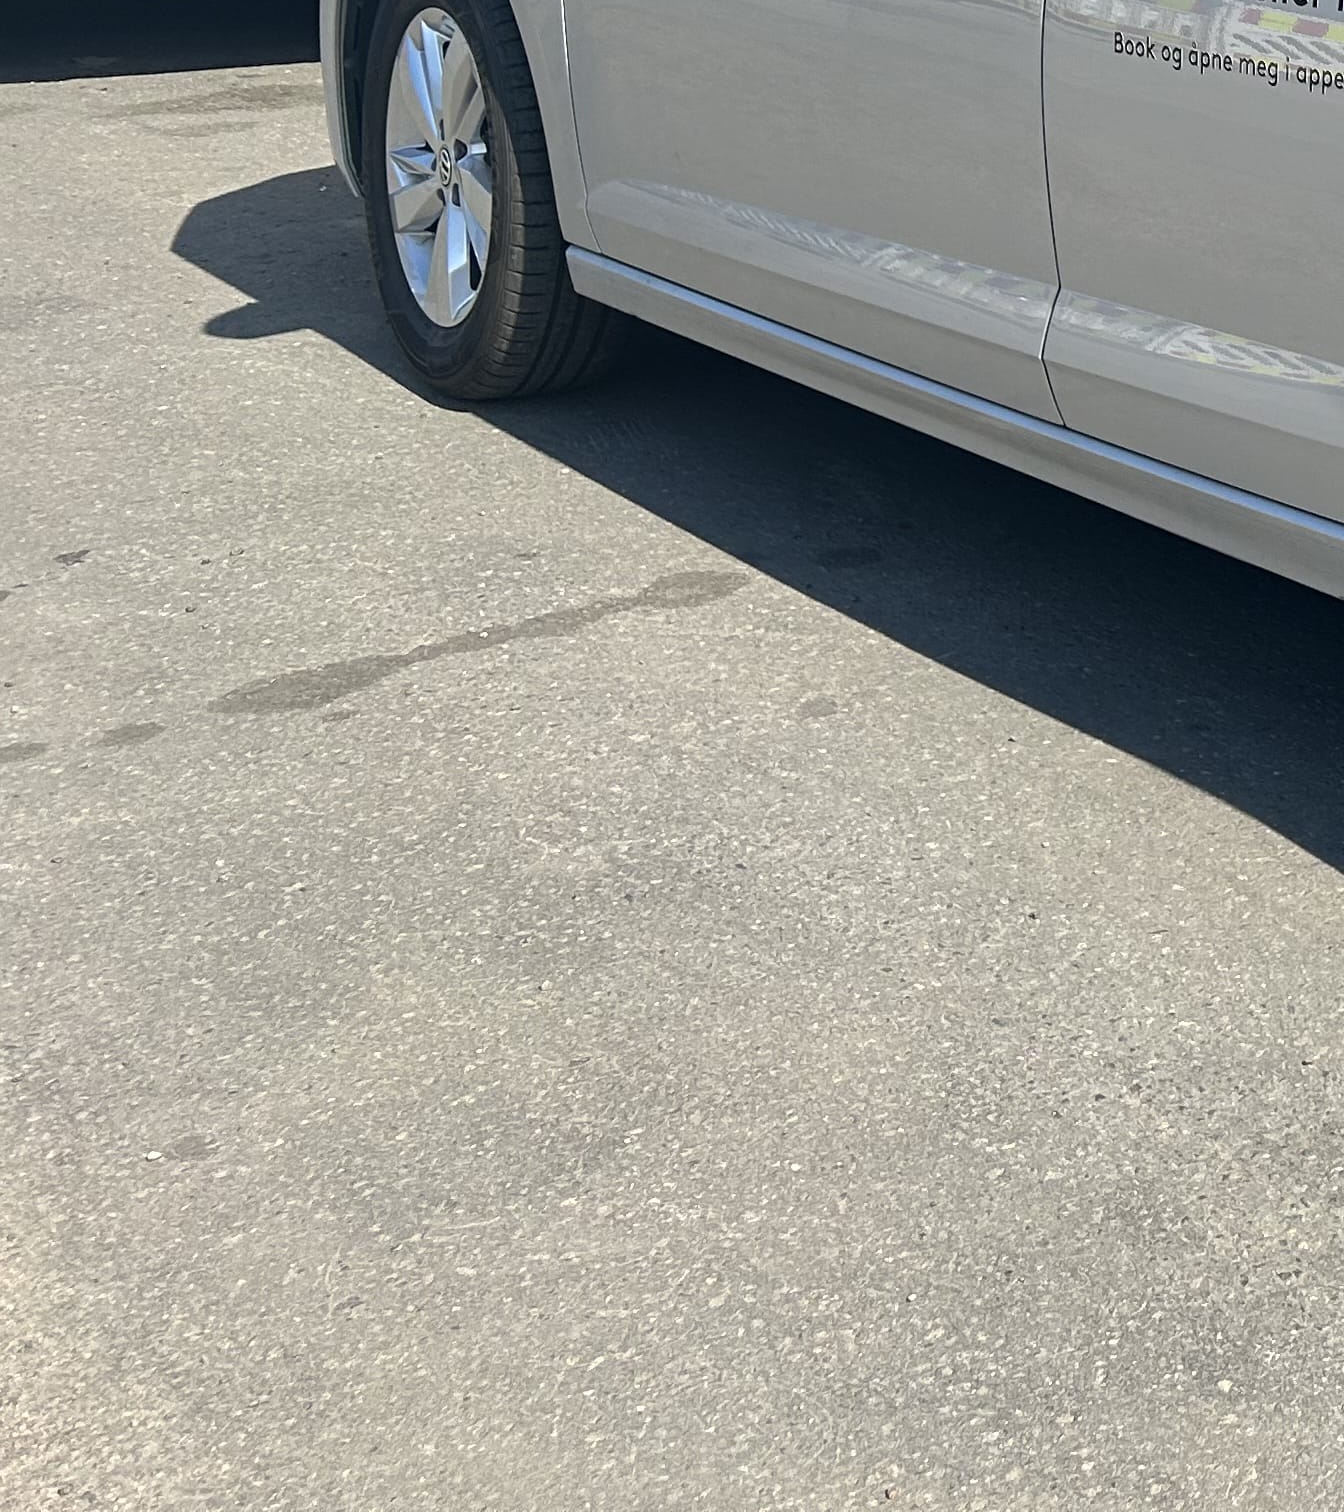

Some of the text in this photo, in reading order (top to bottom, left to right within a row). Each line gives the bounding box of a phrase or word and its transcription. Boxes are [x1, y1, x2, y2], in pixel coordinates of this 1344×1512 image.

[1114, 32, 1156, 59] Book
[1161, 45, 1182, 70] og
[1188, 41, 1233, 75] åpne
[1239, 59, 1279, 86] meg
[1285, 56, 1290, 81] i
